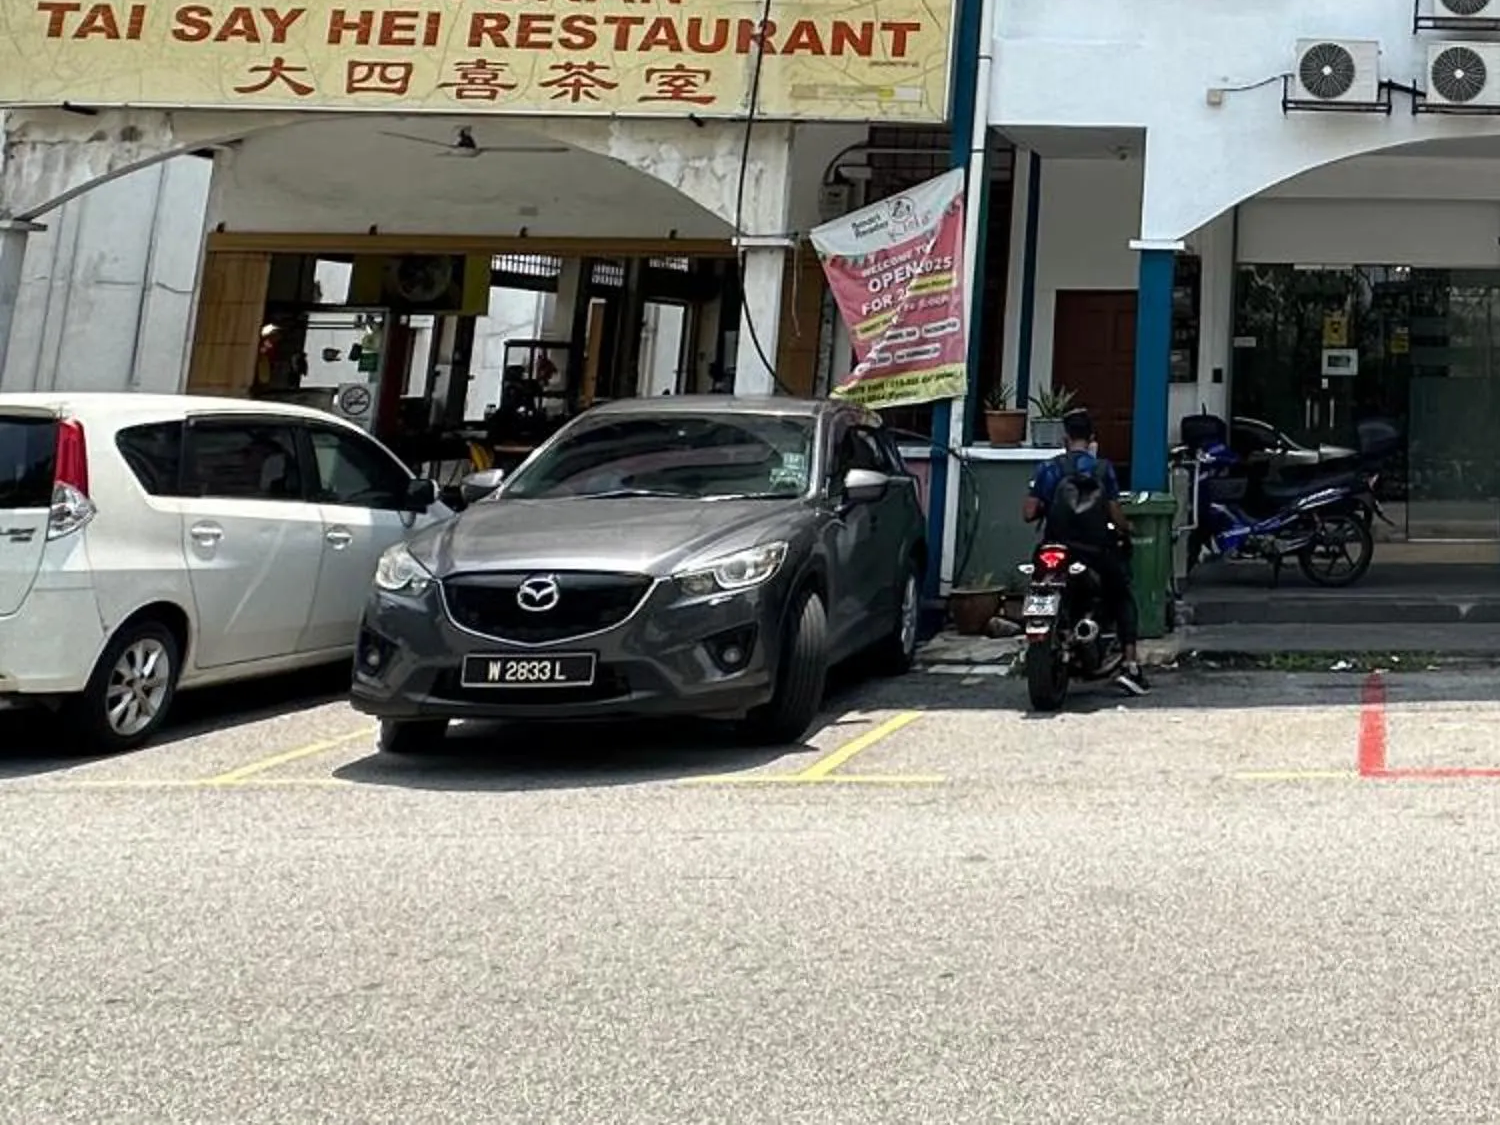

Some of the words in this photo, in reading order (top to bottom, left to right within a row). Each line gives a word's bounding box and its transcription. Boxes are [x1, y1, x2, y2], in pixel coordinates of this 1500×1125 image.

[37, 0, 147, 41] TAI
[171, 3, 306, 45] SAY
[326, 8, 442, 48] HEI
[467, 11, 922, 59] RESTAURANT
[233, 56, 718, 106] 大四喜茶室
[487, 660, 502, 681] W
[504, 660, 552, 682] 2833
[554, 661, 567, 681] L
